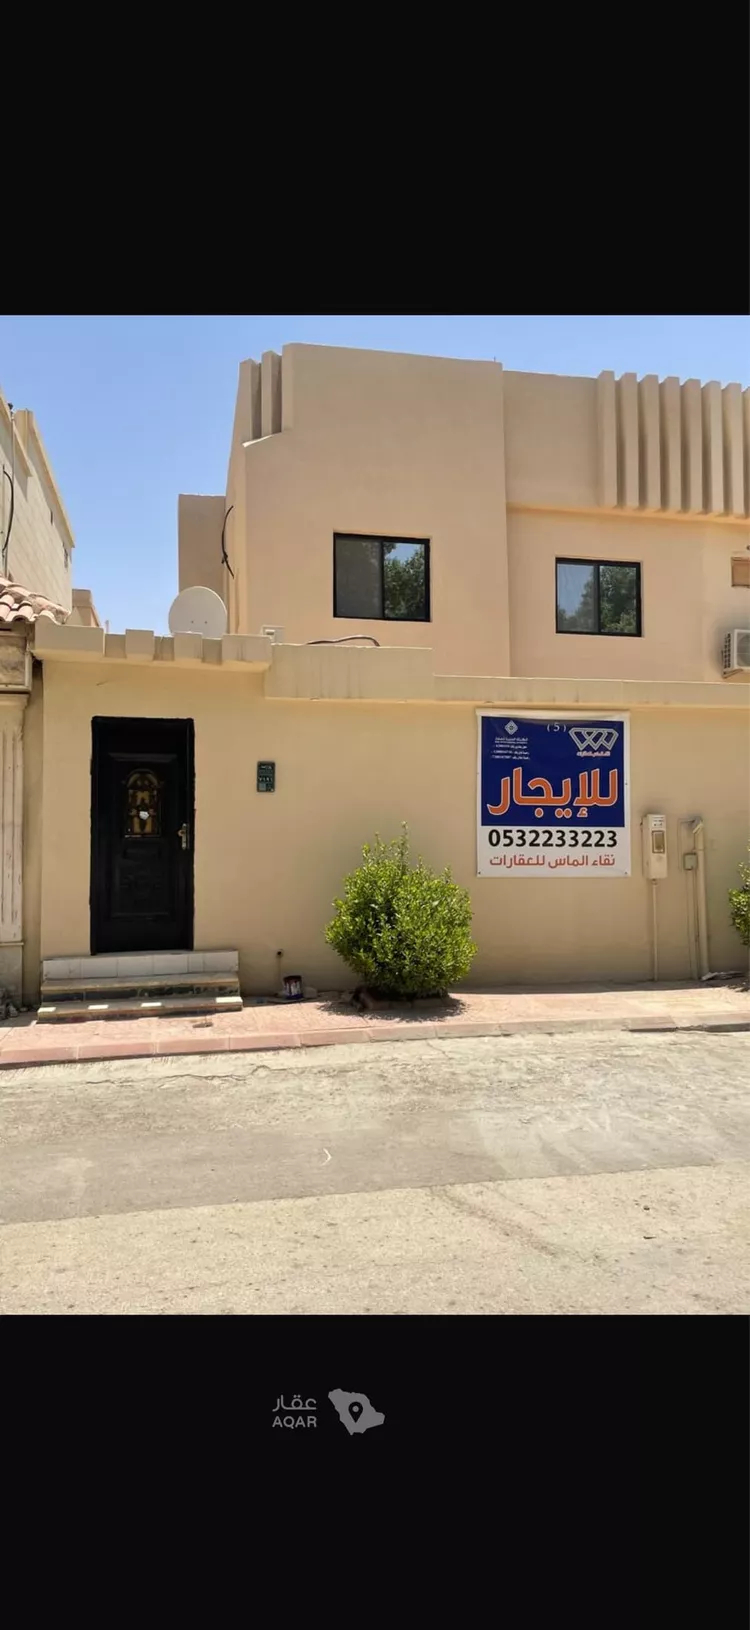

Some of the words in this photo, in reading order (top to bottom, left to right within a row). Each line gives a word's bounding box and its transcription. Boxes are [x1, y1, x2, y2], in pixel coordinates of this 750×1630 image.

[487, 767, 618, 818] للإيجار
[488, 829, 617, 847] 0532233223
[490, 854, 545, 868] للعقارات
[548, 855, 588, 868] الماس
[592, 854, 615, 866] نقاء
